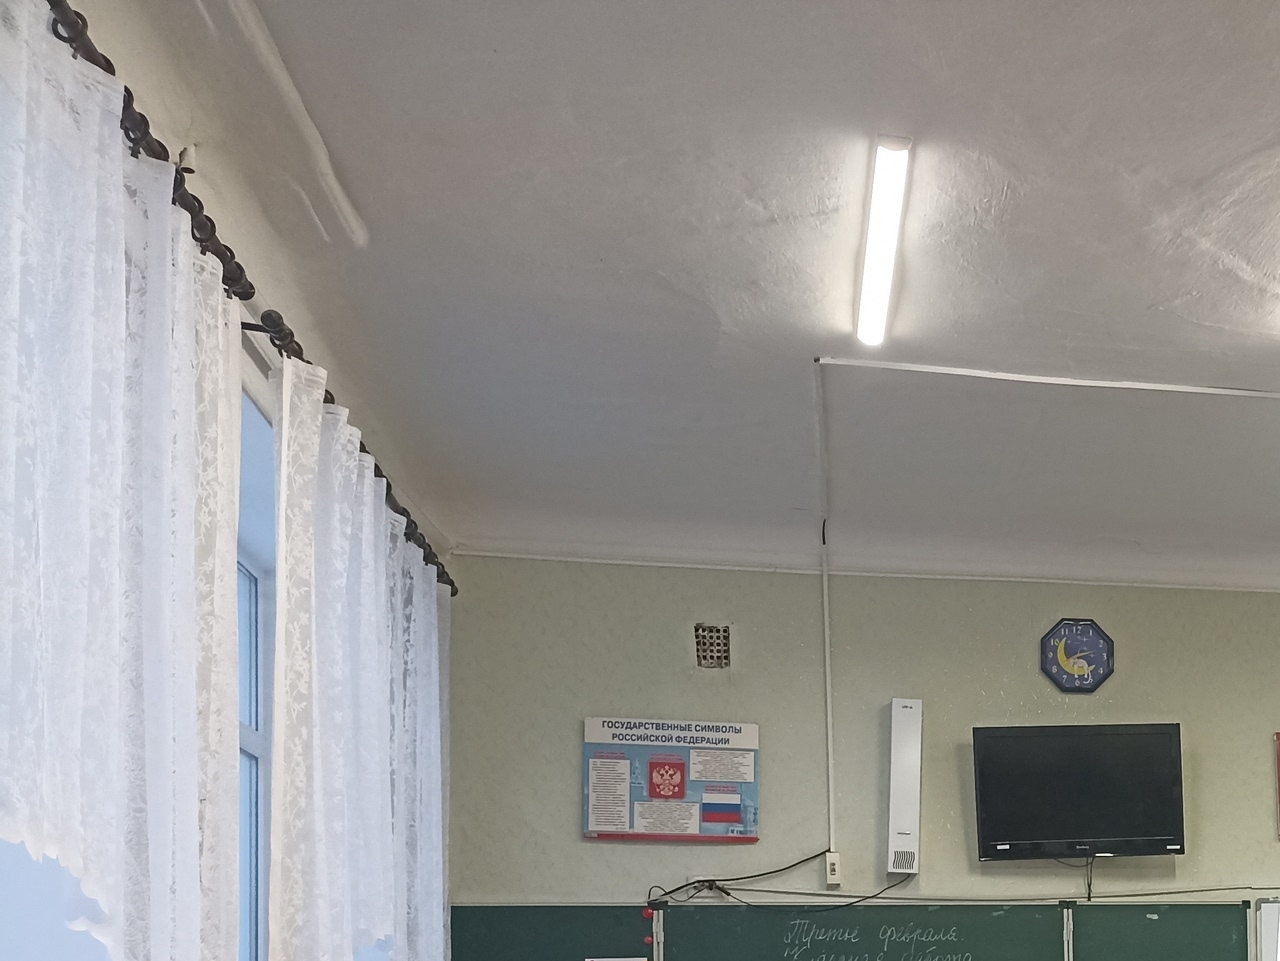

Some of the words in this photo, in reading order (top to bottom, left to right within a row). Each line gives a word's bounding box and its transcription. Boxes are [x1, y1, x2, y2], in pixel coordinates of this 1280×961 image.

[1099, 639, 1103, 647] 2
[1052, 665, 1057, 673] 8
[1062, 675, 1067, 683] 7
[602, 720, 693, 733] ГОСУДАРСТВЕННЫЕ
[694, 724, 742, 734] СИМВОЛЫ
[611, 732, 674, 743] РОССИЙСКОЙ
[674, 735, 730, 746] ФЕДЕРАЦИИ
